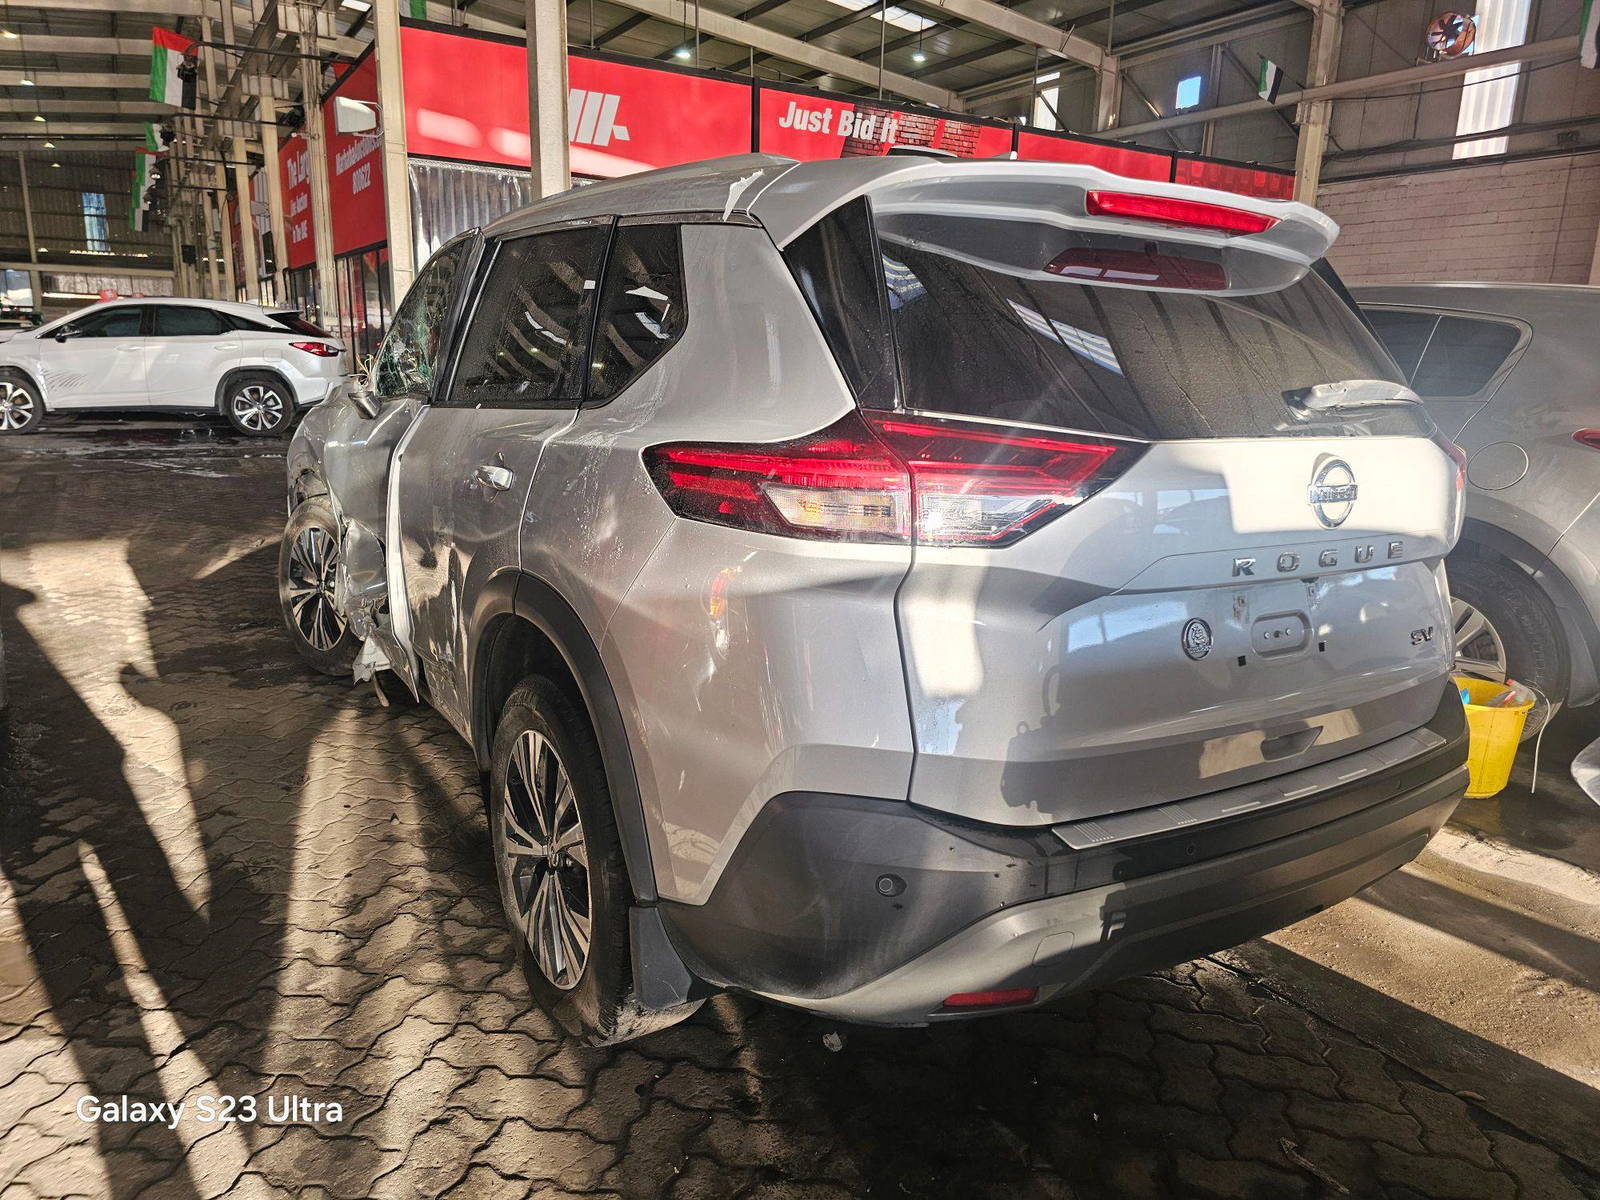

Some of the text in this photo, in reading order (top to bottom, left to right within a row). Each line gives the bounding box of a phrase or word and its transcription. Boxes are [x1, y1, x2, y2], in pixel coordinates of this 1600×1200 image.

[779, 101, 898, 144] Just Bid It
[297, 150, 310, 185] Larg
[1232, 541, 1403, 577] ROGUE
[1410, 626, 1433, 646] SV
